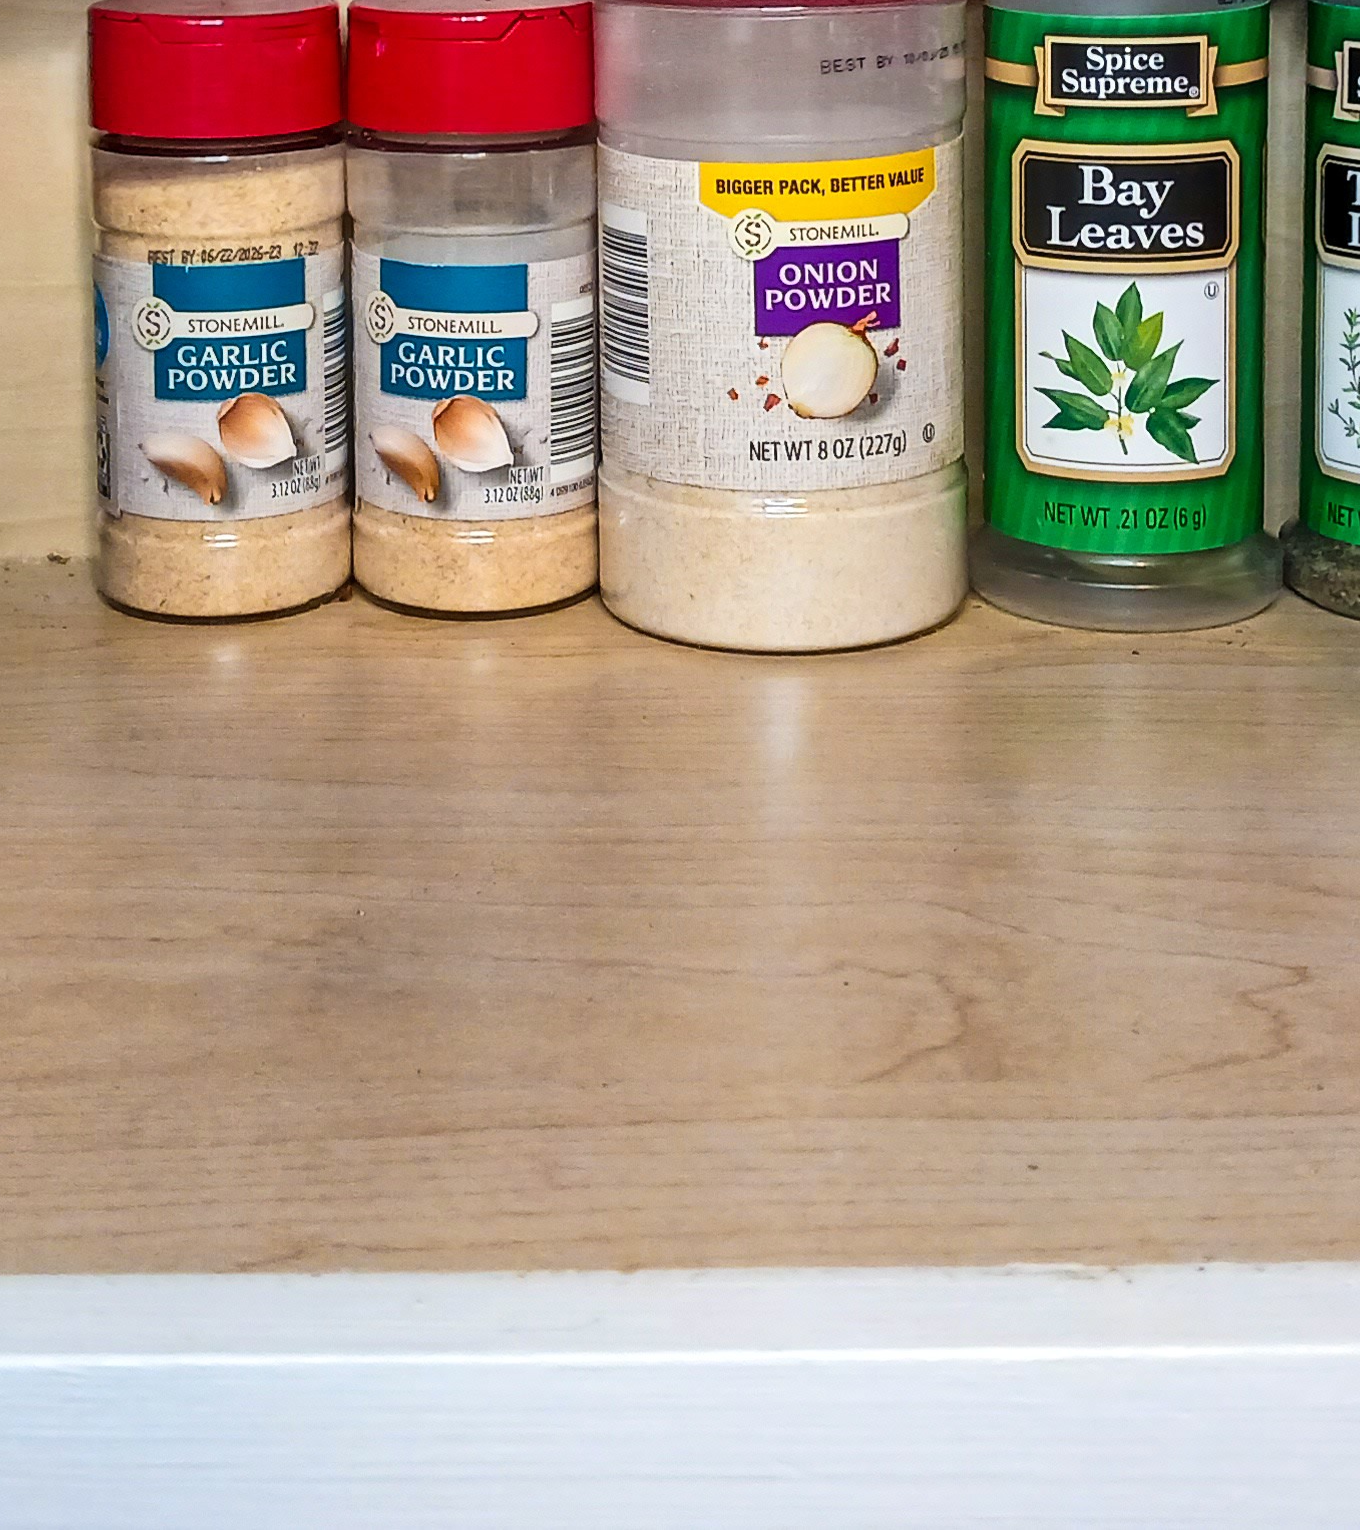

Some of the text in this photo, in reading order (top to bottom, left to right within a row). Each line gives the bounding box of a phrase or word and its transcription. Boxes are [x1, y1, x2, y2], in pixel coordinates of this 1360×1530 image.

[820, 56, 866, 75] BEST
[1086, 45, 1164, 76] Spice
[716, 166, 925, 198] BIGGER PACK, BETTER VALUE
[1078, 164, 1174, 221] Bay
[1045, 205, 1205, 251] Leaves
[779, 259, 878, 286] ONION
[765, 281, 892, 311] POWDER
[177, 339, 288, 367] GARLIC
[398, 341, 506, 368] GARLIC
[167, 363, 297, 392] POWDER
[390, 363, 515, 392] POWDER
[749, 429, 907, 461] NET WT 8 OZ (227g)
[271, 480, 289, 499] 3.12
[290, 477, 302, 495] OZ
[510, 466, 544, 485] NET WT
[484, 487, 504, 504] 3.12
[506, 486, 518, 502] OZ
[520, 485, 544, 504] (88g)
[1044, 501, 1076, 526] NET
[1080, 505, 1111, 529] WT
[1115, 508, 1138, 530] .21
[1146, 507, 1169, 530] OZ
[1327, 501, 1354, 528] NET
